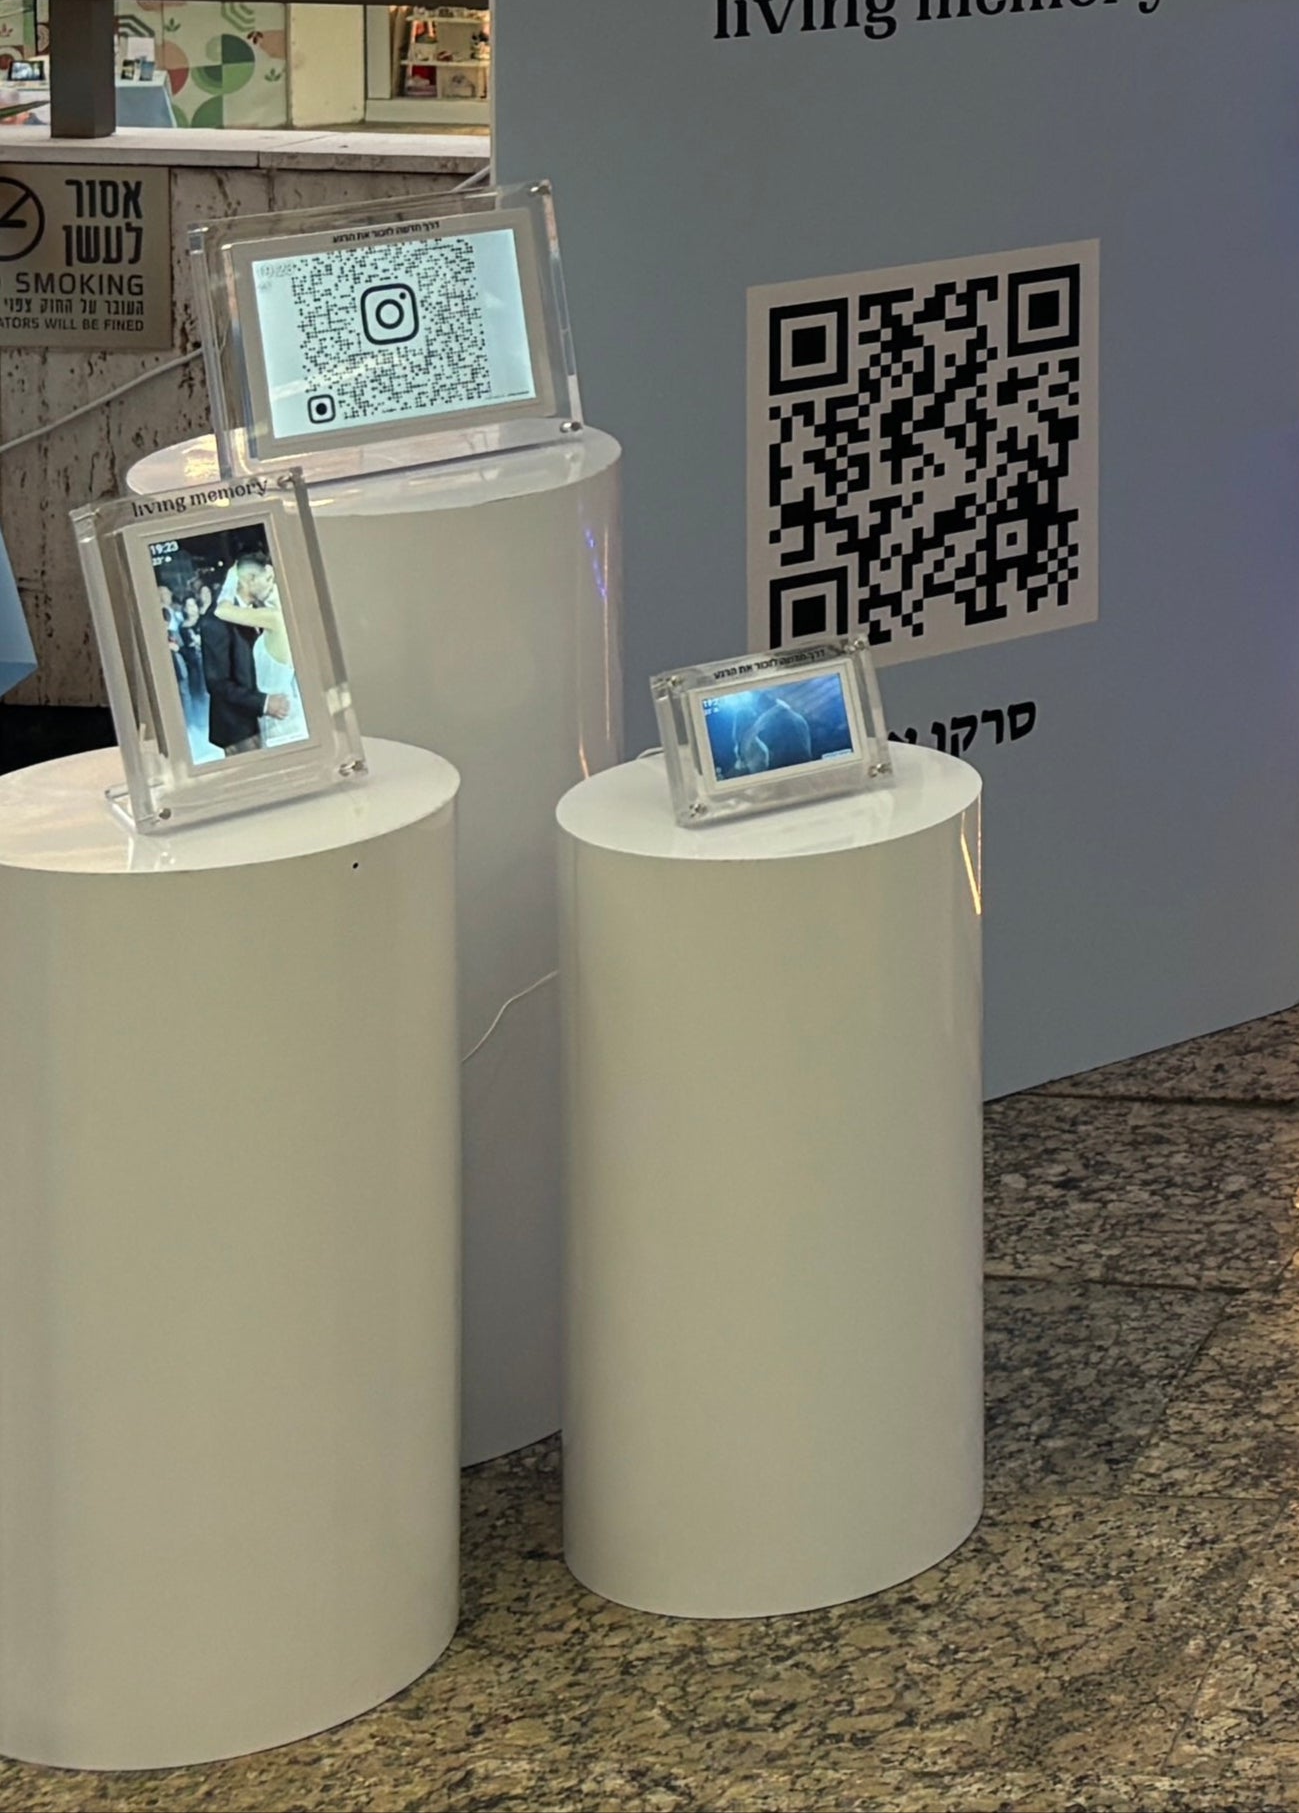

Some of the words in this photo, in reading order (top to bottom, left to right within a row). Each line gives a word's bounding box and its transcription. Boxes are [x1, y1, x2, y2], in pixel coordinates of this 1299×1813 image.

[65, 178, 143, 219] אסור
[62, 222, 143, 267] לעשן
[16, 272, 144, 296] SMOKING
[4, 297, 32, 313] צפוי
[40, 298, 72, 314] החוק
[80, 298, 97, 315] על
[104, 300, 144, 316] העובר
[44, 318, 77, 330] WILL
[82, 319, 99, 330] BE
[104, 319, 144, 331] FINED
[131, 494, 187, 518] living
[190, 479, 267, 506] memory
[150, 541, 179, 556] 19:23
